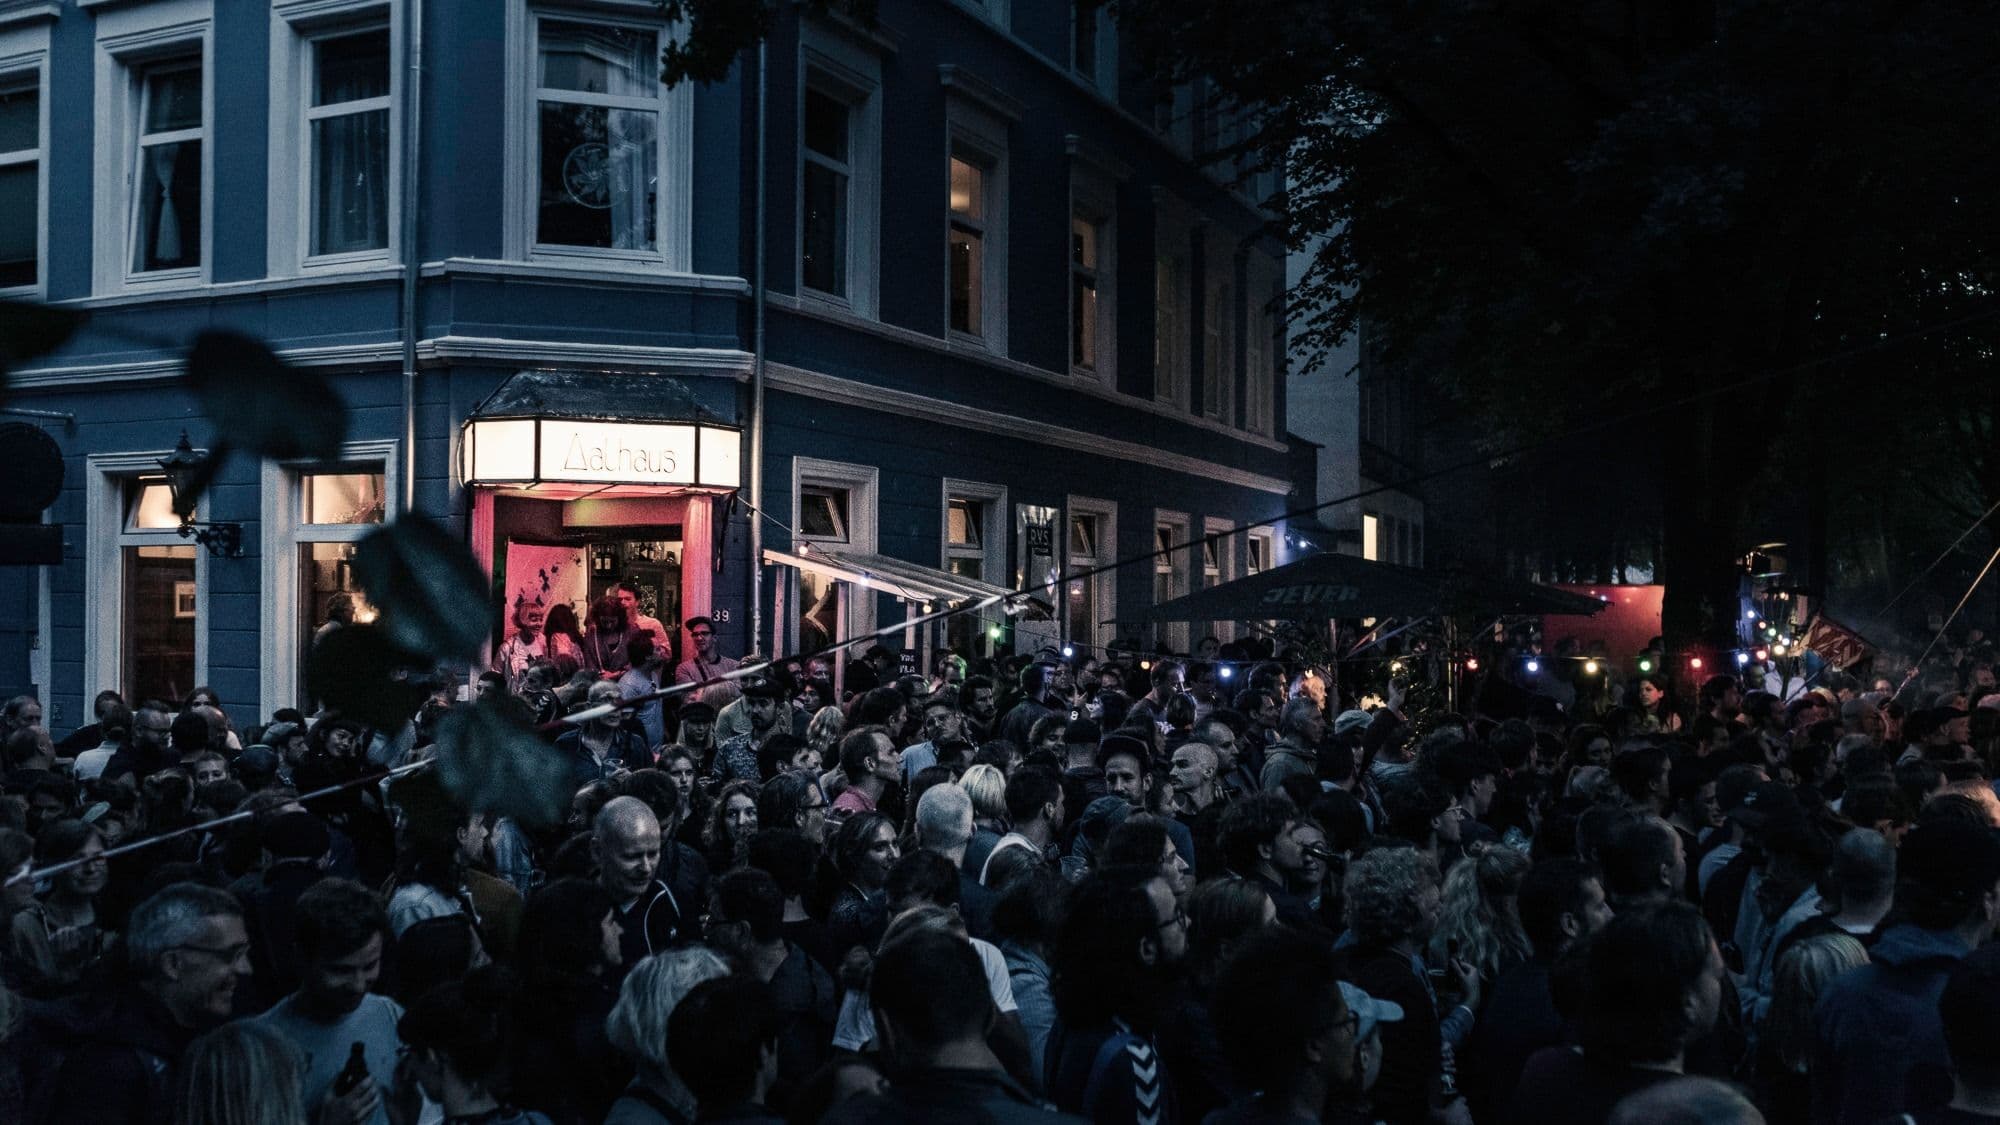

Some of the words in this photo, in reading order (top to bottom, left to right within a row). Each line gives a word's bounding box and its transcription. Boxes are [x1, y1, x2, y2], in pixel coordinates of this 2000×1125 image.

[564, 432, 676, 474] Aalhaus
[1263, 584, 1360, 604] JEVER
[713, 609, 729, 622] 39
